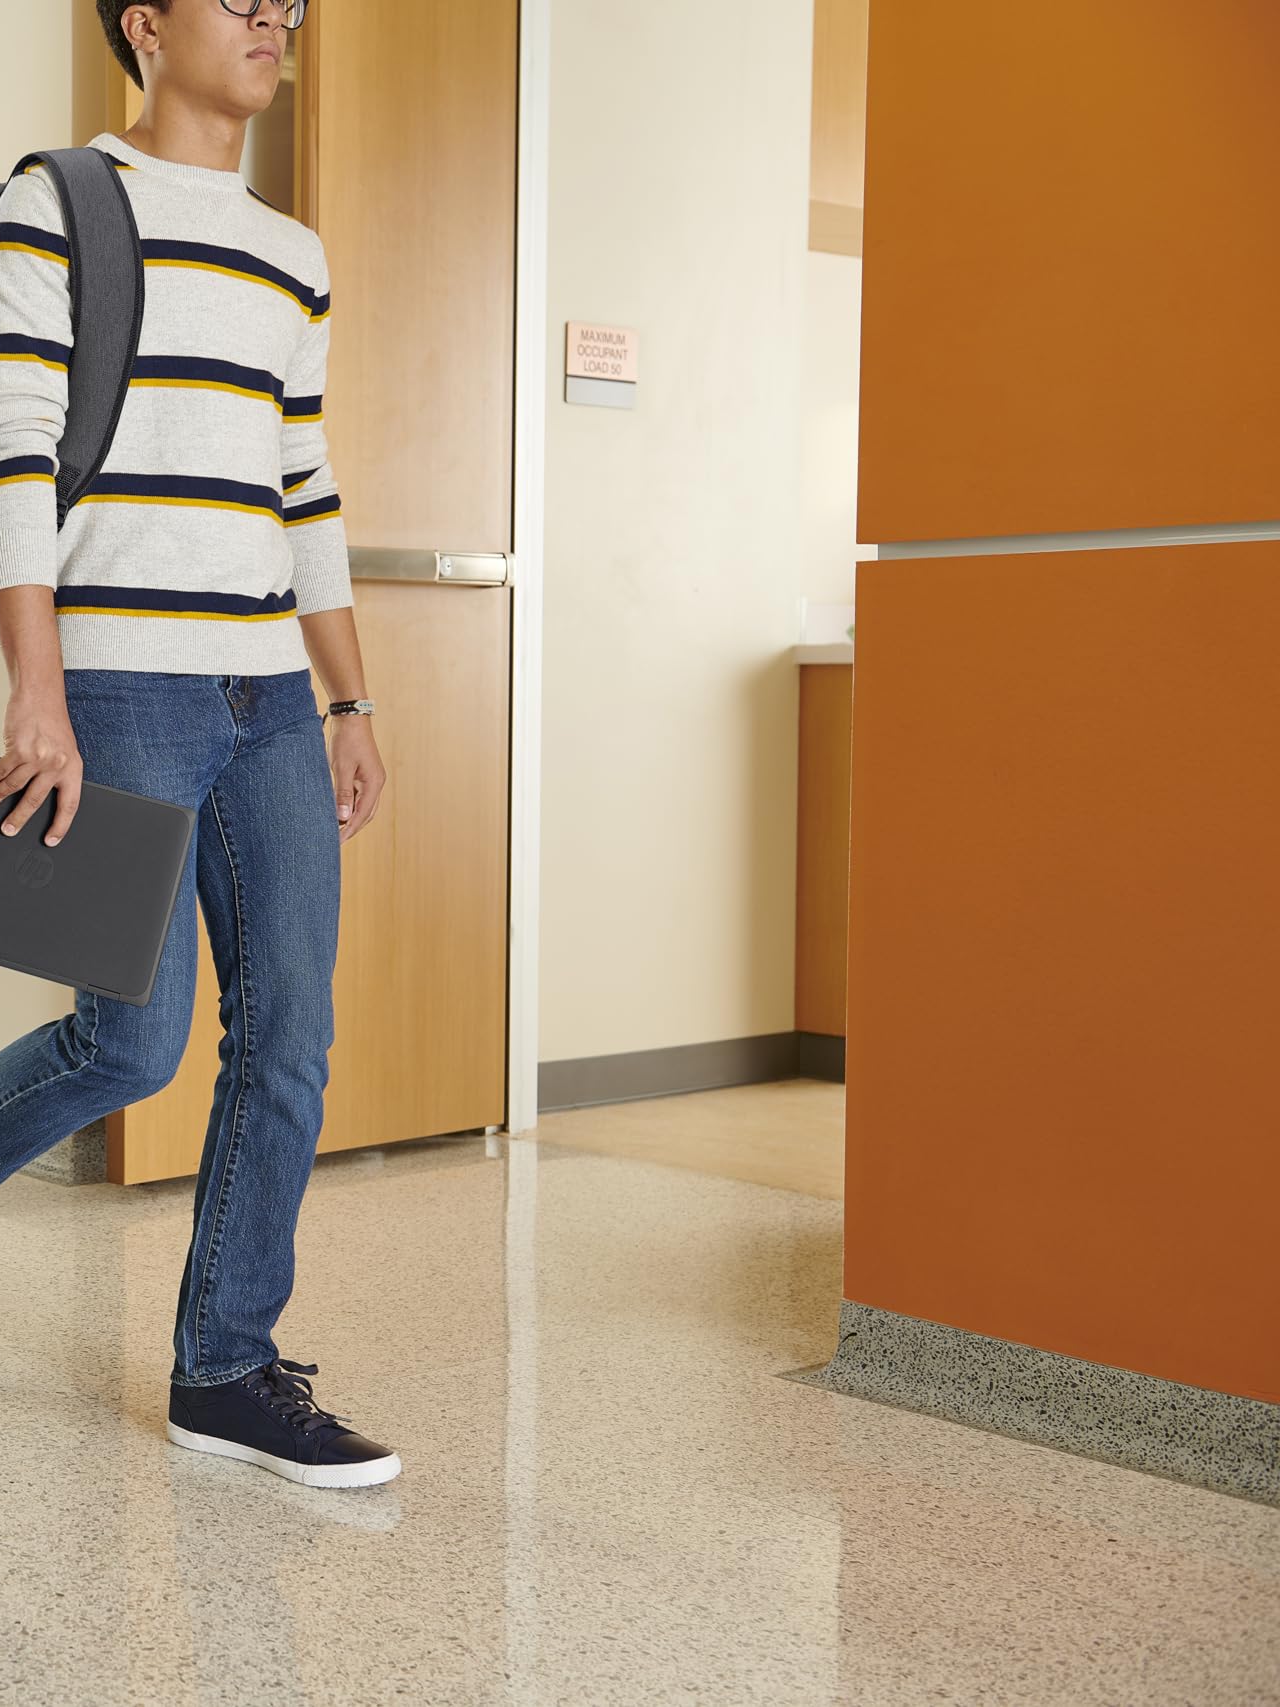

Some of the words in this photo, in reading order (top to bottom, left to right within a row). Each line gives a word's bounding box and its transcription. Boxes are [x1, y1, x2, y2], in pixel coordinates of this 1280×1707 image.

[581, 328, 626, 345] MAXIMUM
[576, 343, 628, 360] OCCUPANT
[583, 360, 609, 373] LOAD
[611, 363, 622, 375] 50
